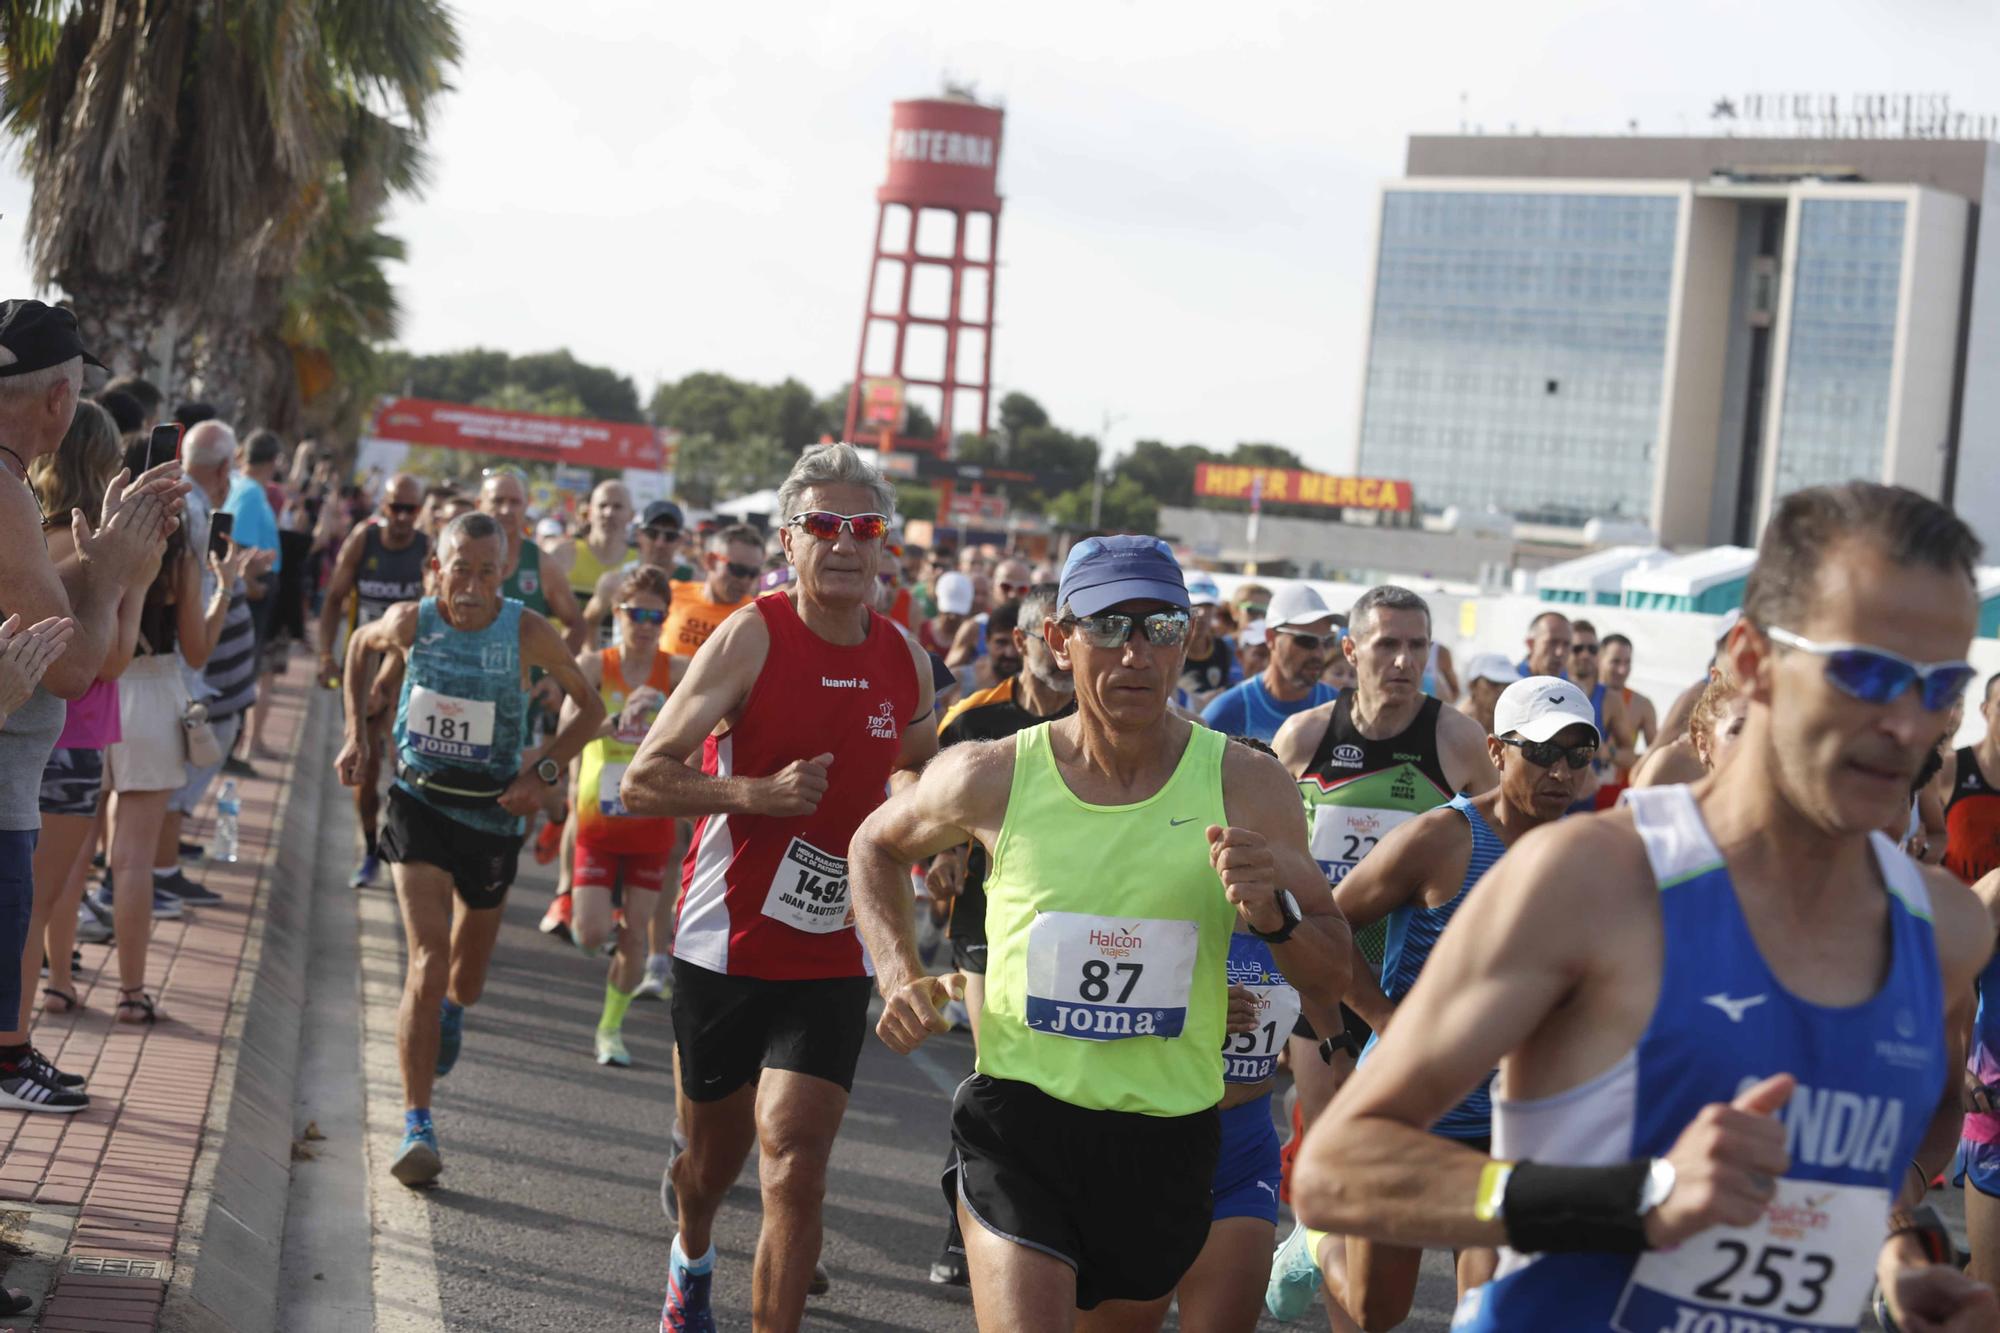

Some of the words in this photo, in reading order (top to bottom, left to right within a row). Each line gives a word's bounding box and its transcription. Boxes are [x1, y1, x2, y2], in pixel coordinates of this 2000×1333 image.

[894, 128, 993, 168] PATERNA
[1300, 472, 1399, 509] MERCA
[822, 676, 857, 688] luanvi
[425, 714, 470, 741] 181
[1337, 748, 1360, 758] KIA
[797, 847, 814, 859] MEDIA
[779, 893, 805, 909] JUAN
[795, 869, 848, 904] 1492
[1101, 947, 1130, 959] viajes
[1079, 960, 1144, 1004] 87
[1221, 1020, 1277, 1054] 51
[1694, 1239, 1835, 1317] 253
